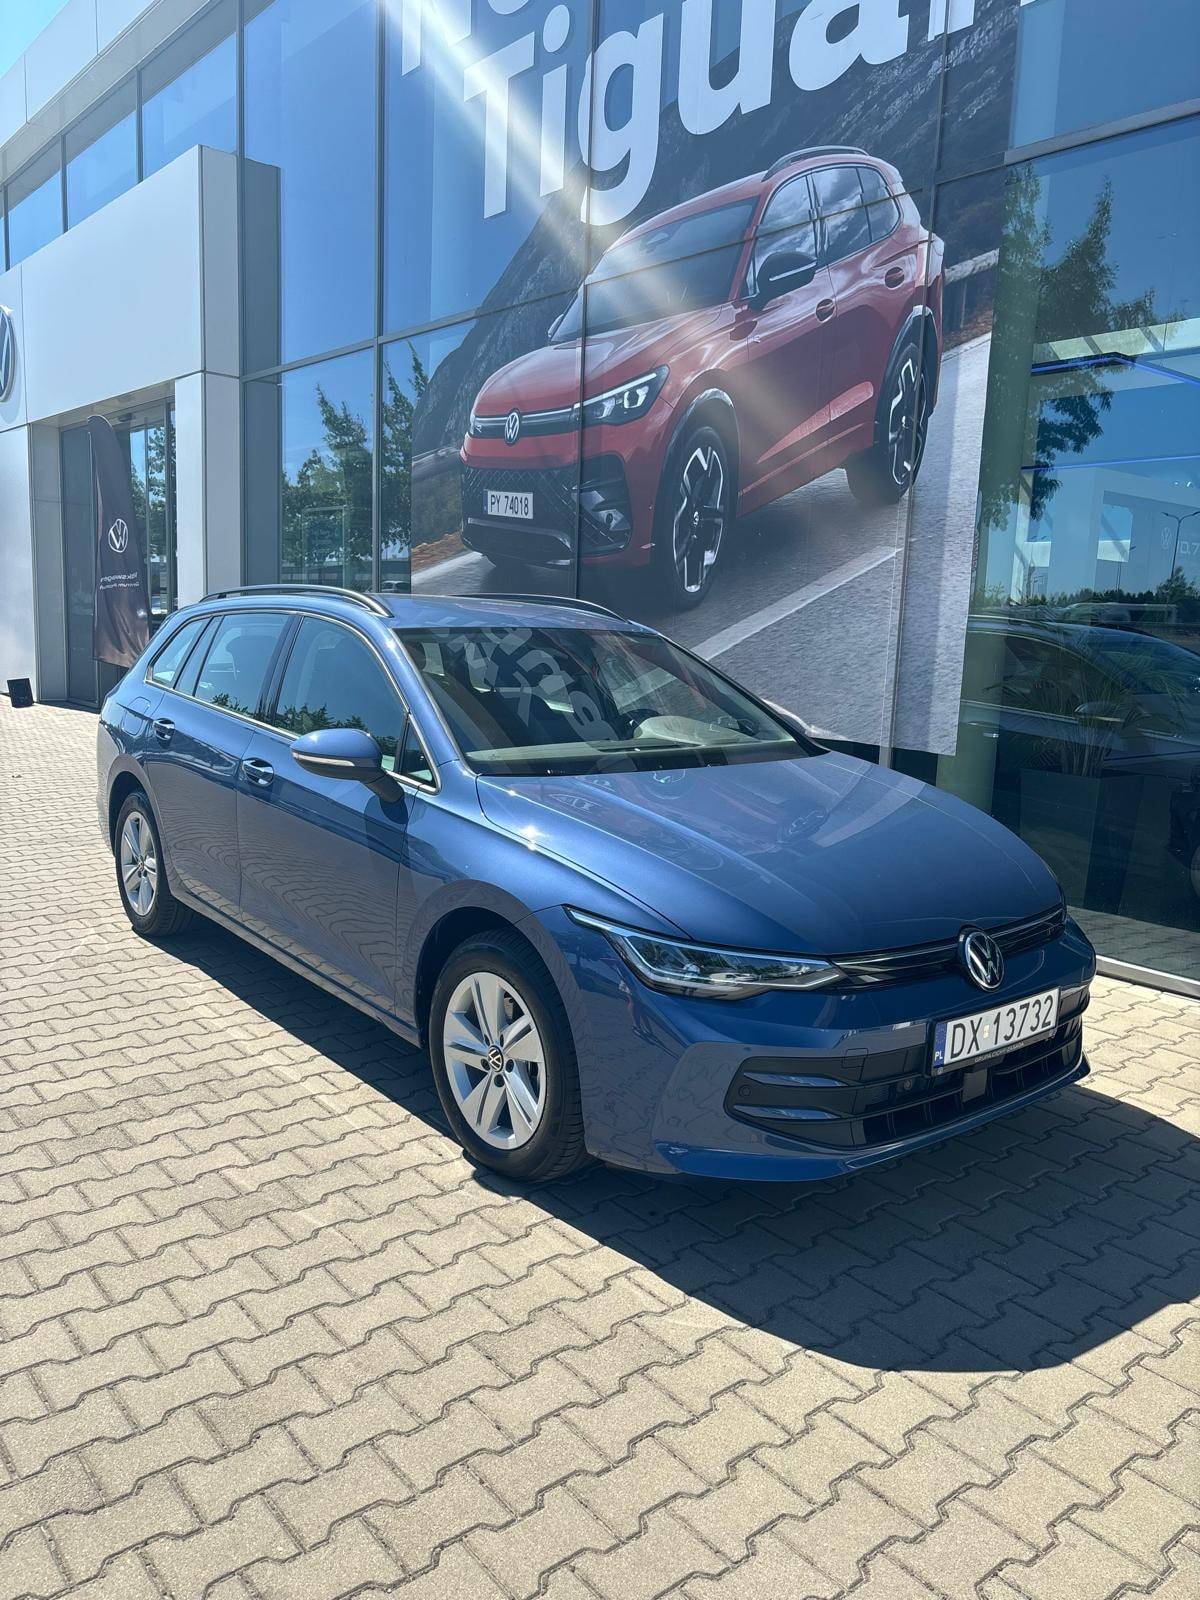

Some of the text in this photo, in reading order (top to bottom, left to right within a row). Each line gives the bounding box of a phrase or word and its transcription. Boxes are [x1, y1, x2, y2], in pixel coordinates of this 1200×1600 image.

[462, 0, 1036, 226] Tigua
[490, 494, 529, 516] PY 74018
[951, 994, 1054, 1059] DX 13732
[934, 1050, 944, 1061] PL
